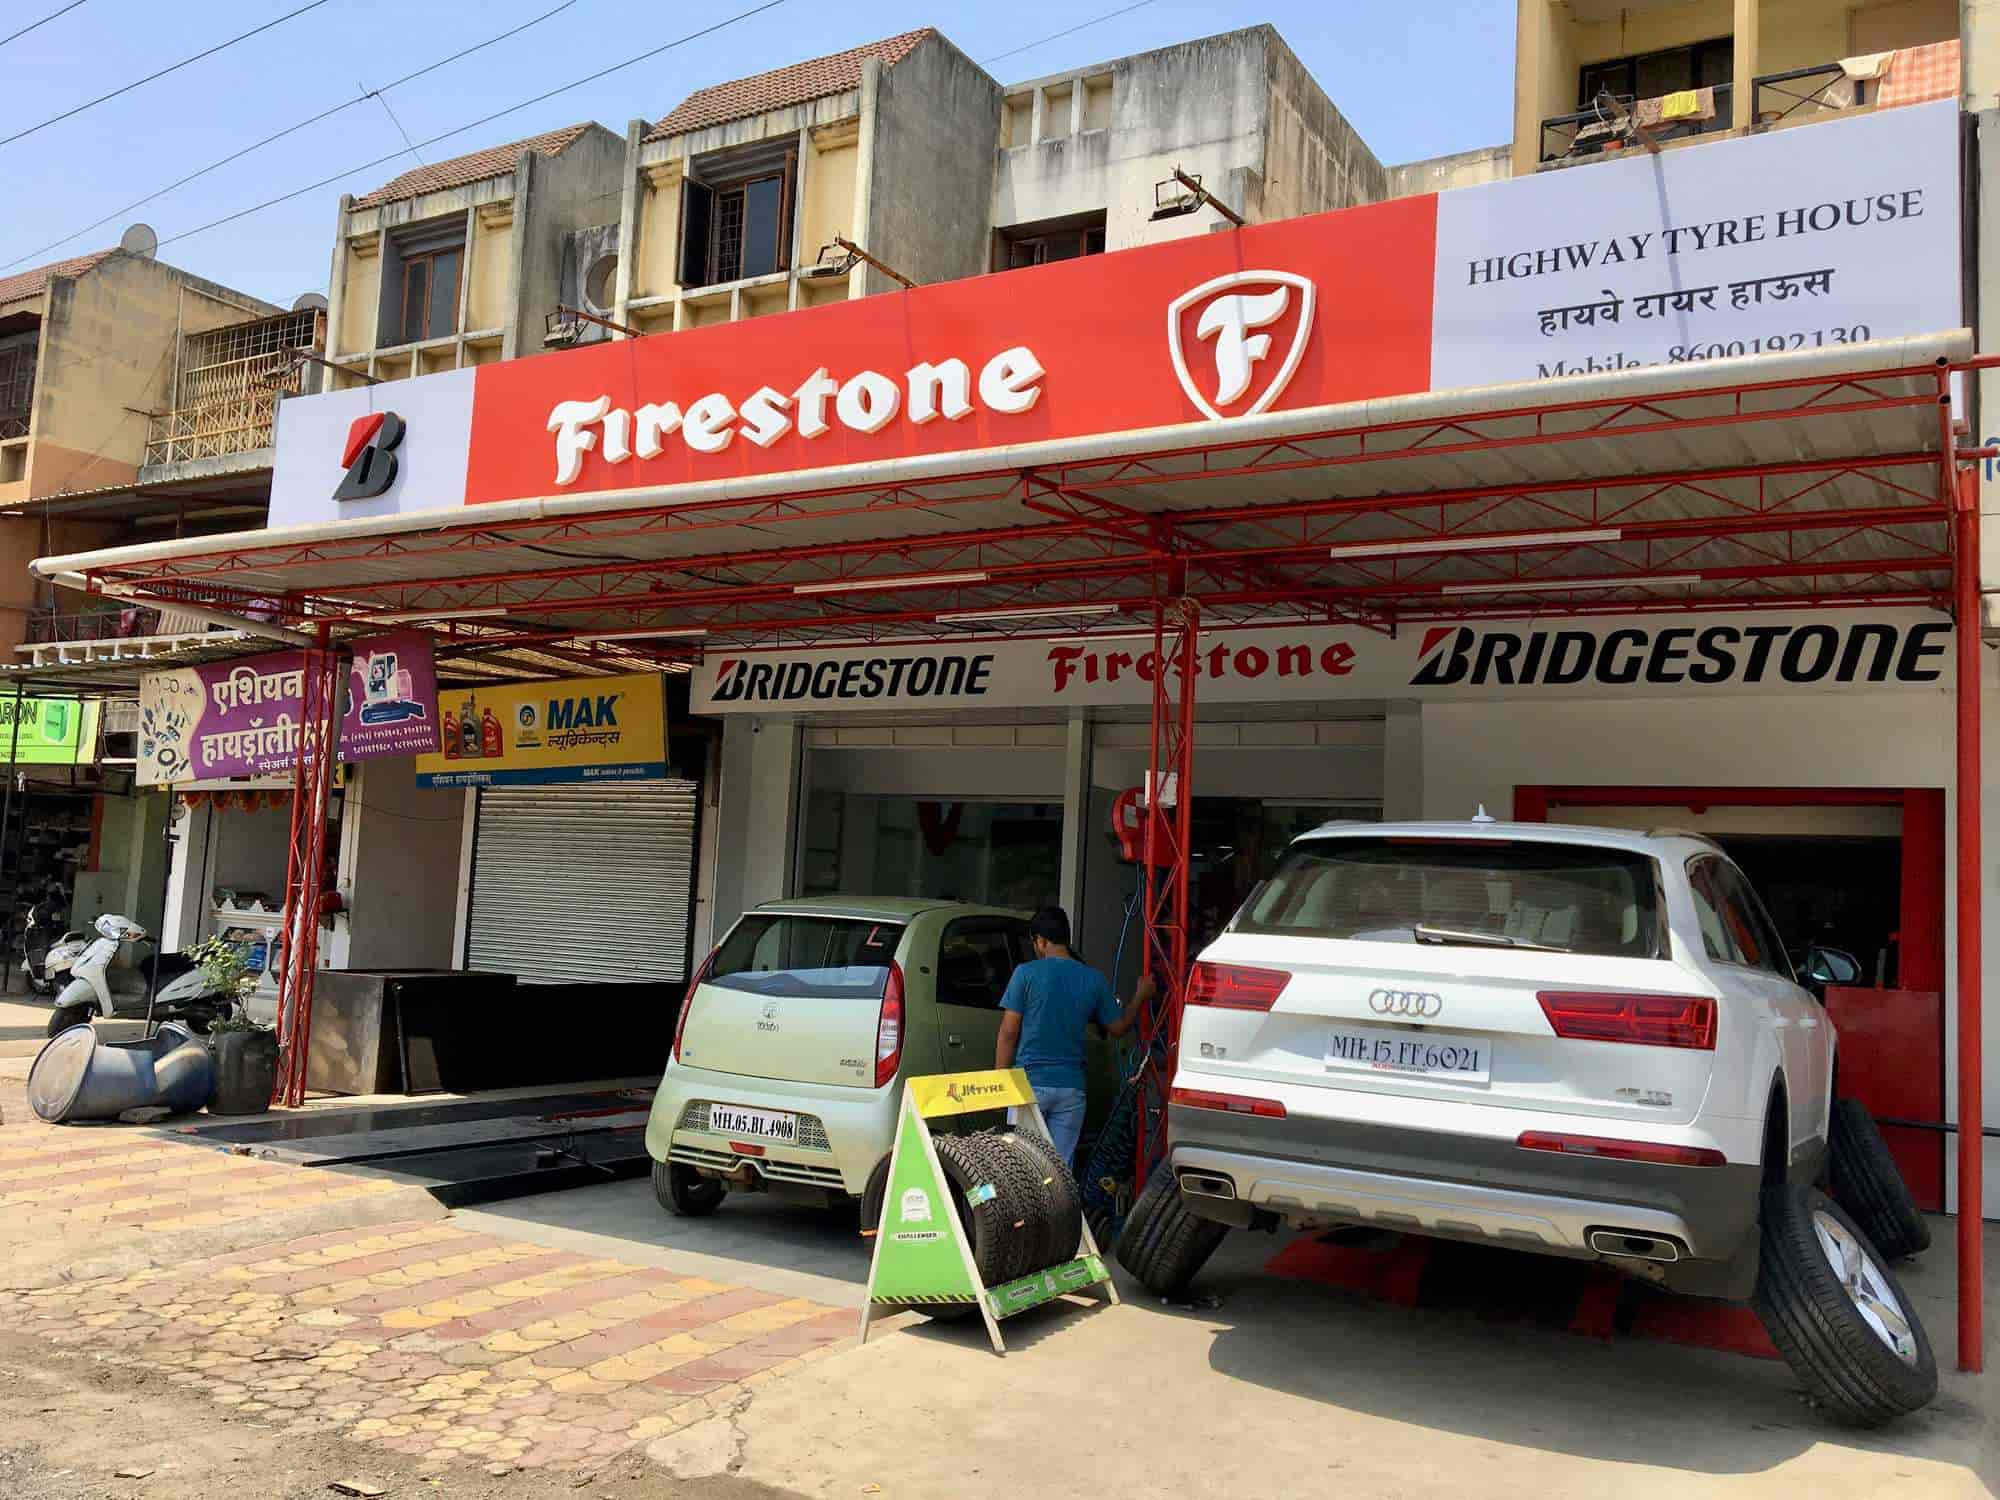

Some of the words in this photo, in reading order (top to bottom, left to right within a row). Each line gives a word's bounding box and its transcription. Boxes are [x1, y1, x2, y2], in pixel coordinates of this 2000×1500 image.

[1468, 232, 1653, 285] HIGHWAY
[1662, 215, 1765, 255] TYRE
[1776, 189, 1924, 237] HOUSE
[1538, 289, 1624, 338] हायवे
[1634, 284, 1718, 319] टायर
[1729, 267, 1835, 310] हाऊस
[546, 345, 1047, 486] Firestone
[212, 665, 304, 716] एशियन
[711, 654, 994, 701] BRIDGESTONE
[1409, 622, 1953, 685] BRIDGESTONE
[547, 694, 619, 730] MAK
[712, 1111, 794, 1139] MH.05.BL.4908
